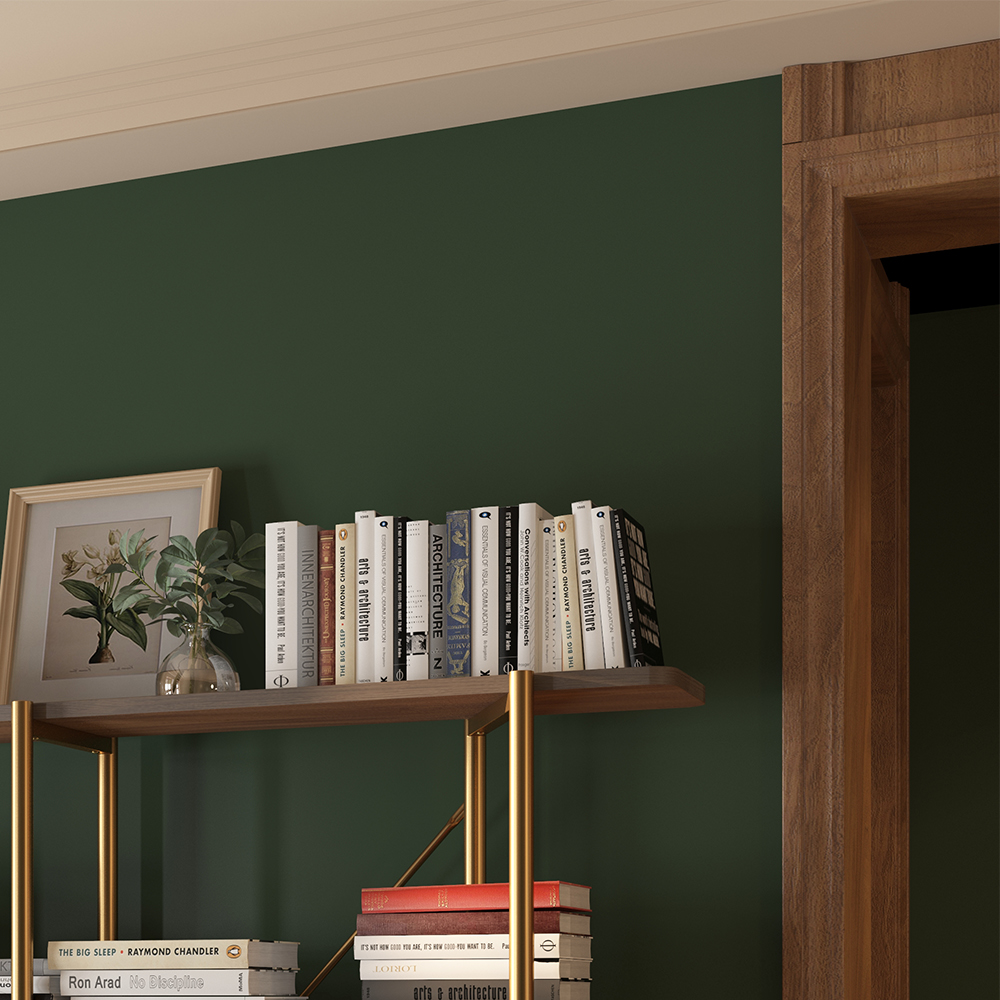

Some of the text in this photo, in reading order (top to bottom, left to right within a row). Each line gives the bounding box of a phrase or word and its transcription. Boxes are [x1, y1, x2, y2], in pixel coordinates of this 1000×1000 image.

[359, 558, 370, 574] arts
[560, 538, 568, 575] CHANDLER
[579, 548, 591, 565] arts
[433, 534, 443, 638] ARCHITECTURE
[562, 577, 570, 613] RAYMOND
[302, 550, 314, 678] INNENARCHITEKTUR
[359, 589, 371, 642] architecture
[581, 579, 596, 632] architecture
[76, 948, 91, 956] BIG
[93, 948, 116, 956] SLEEP
[127, 947, 171, 956] RAYMOND
[174, 947, 219, 955] CHANDLER
[373, 965, 417, 973] LORIOT
[69, 975, 204, 991] Ron Arad No Discipline
[413, 985, 432, 1000] arts
[448, 984, 507, 1000] architecture
